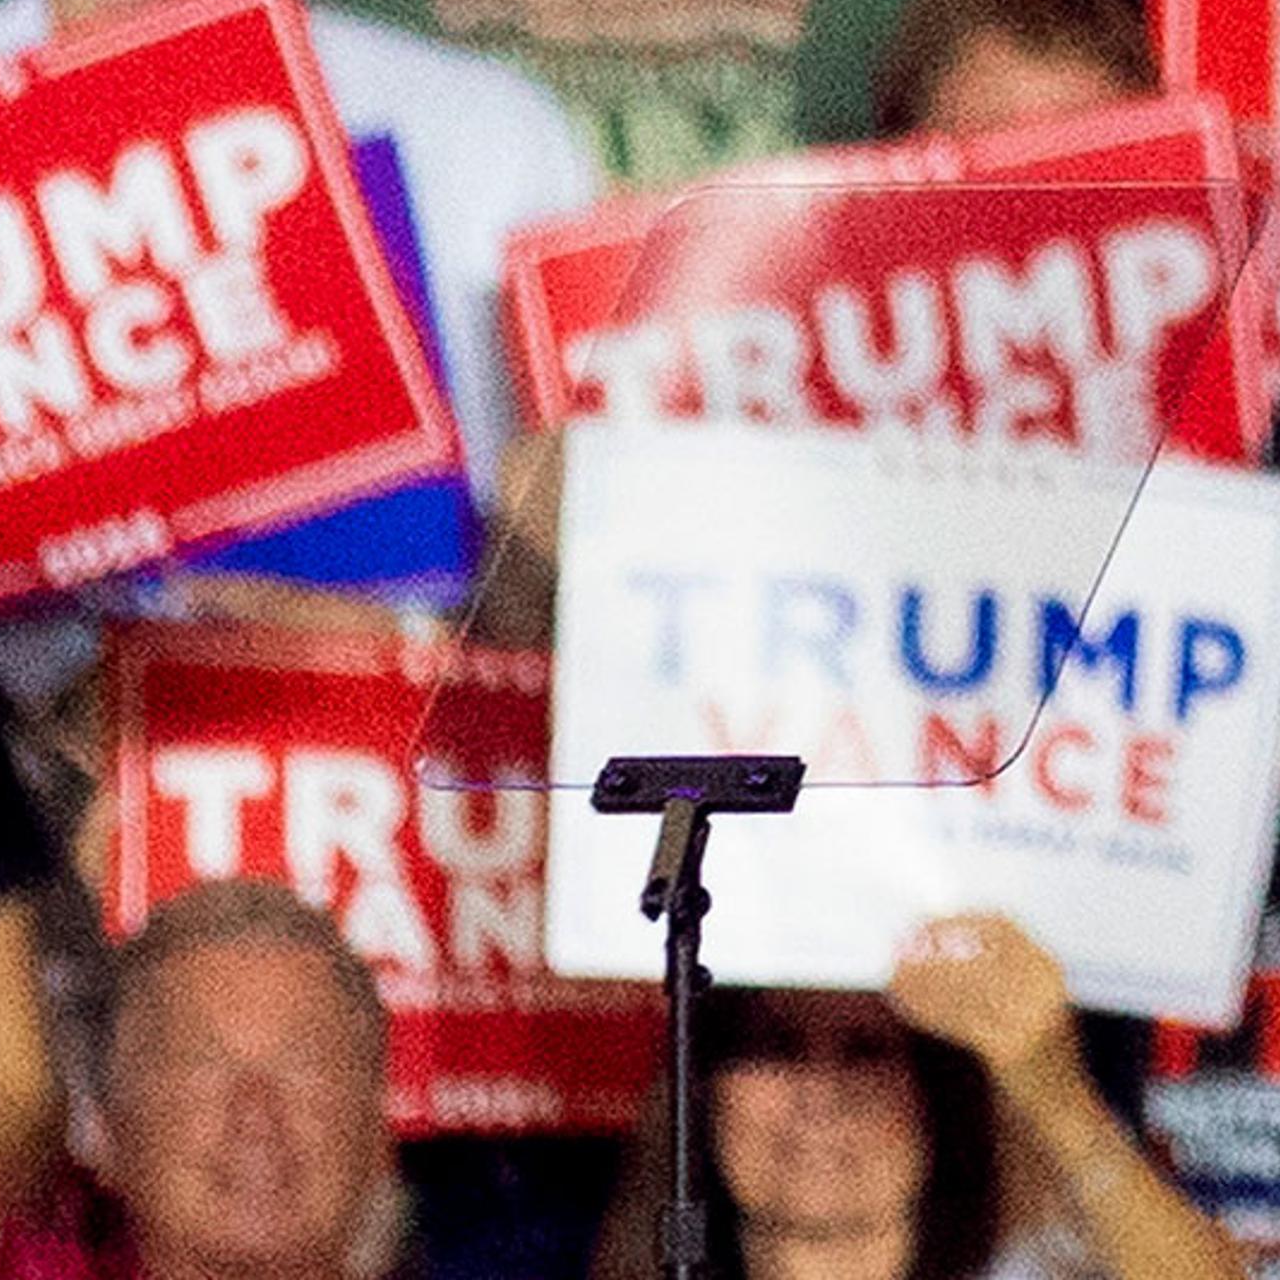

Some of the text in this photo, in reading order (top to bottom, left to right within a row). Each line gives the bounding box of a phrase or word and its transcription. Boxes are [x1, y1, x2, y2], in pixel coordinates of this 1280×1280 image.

[562, 218, 1220, 435] TRUMP
[625, 568, 1248, 722] TRUMP
[148, 745, 550, 910] TRU
[698, 695, 1182, 830] VANCE
